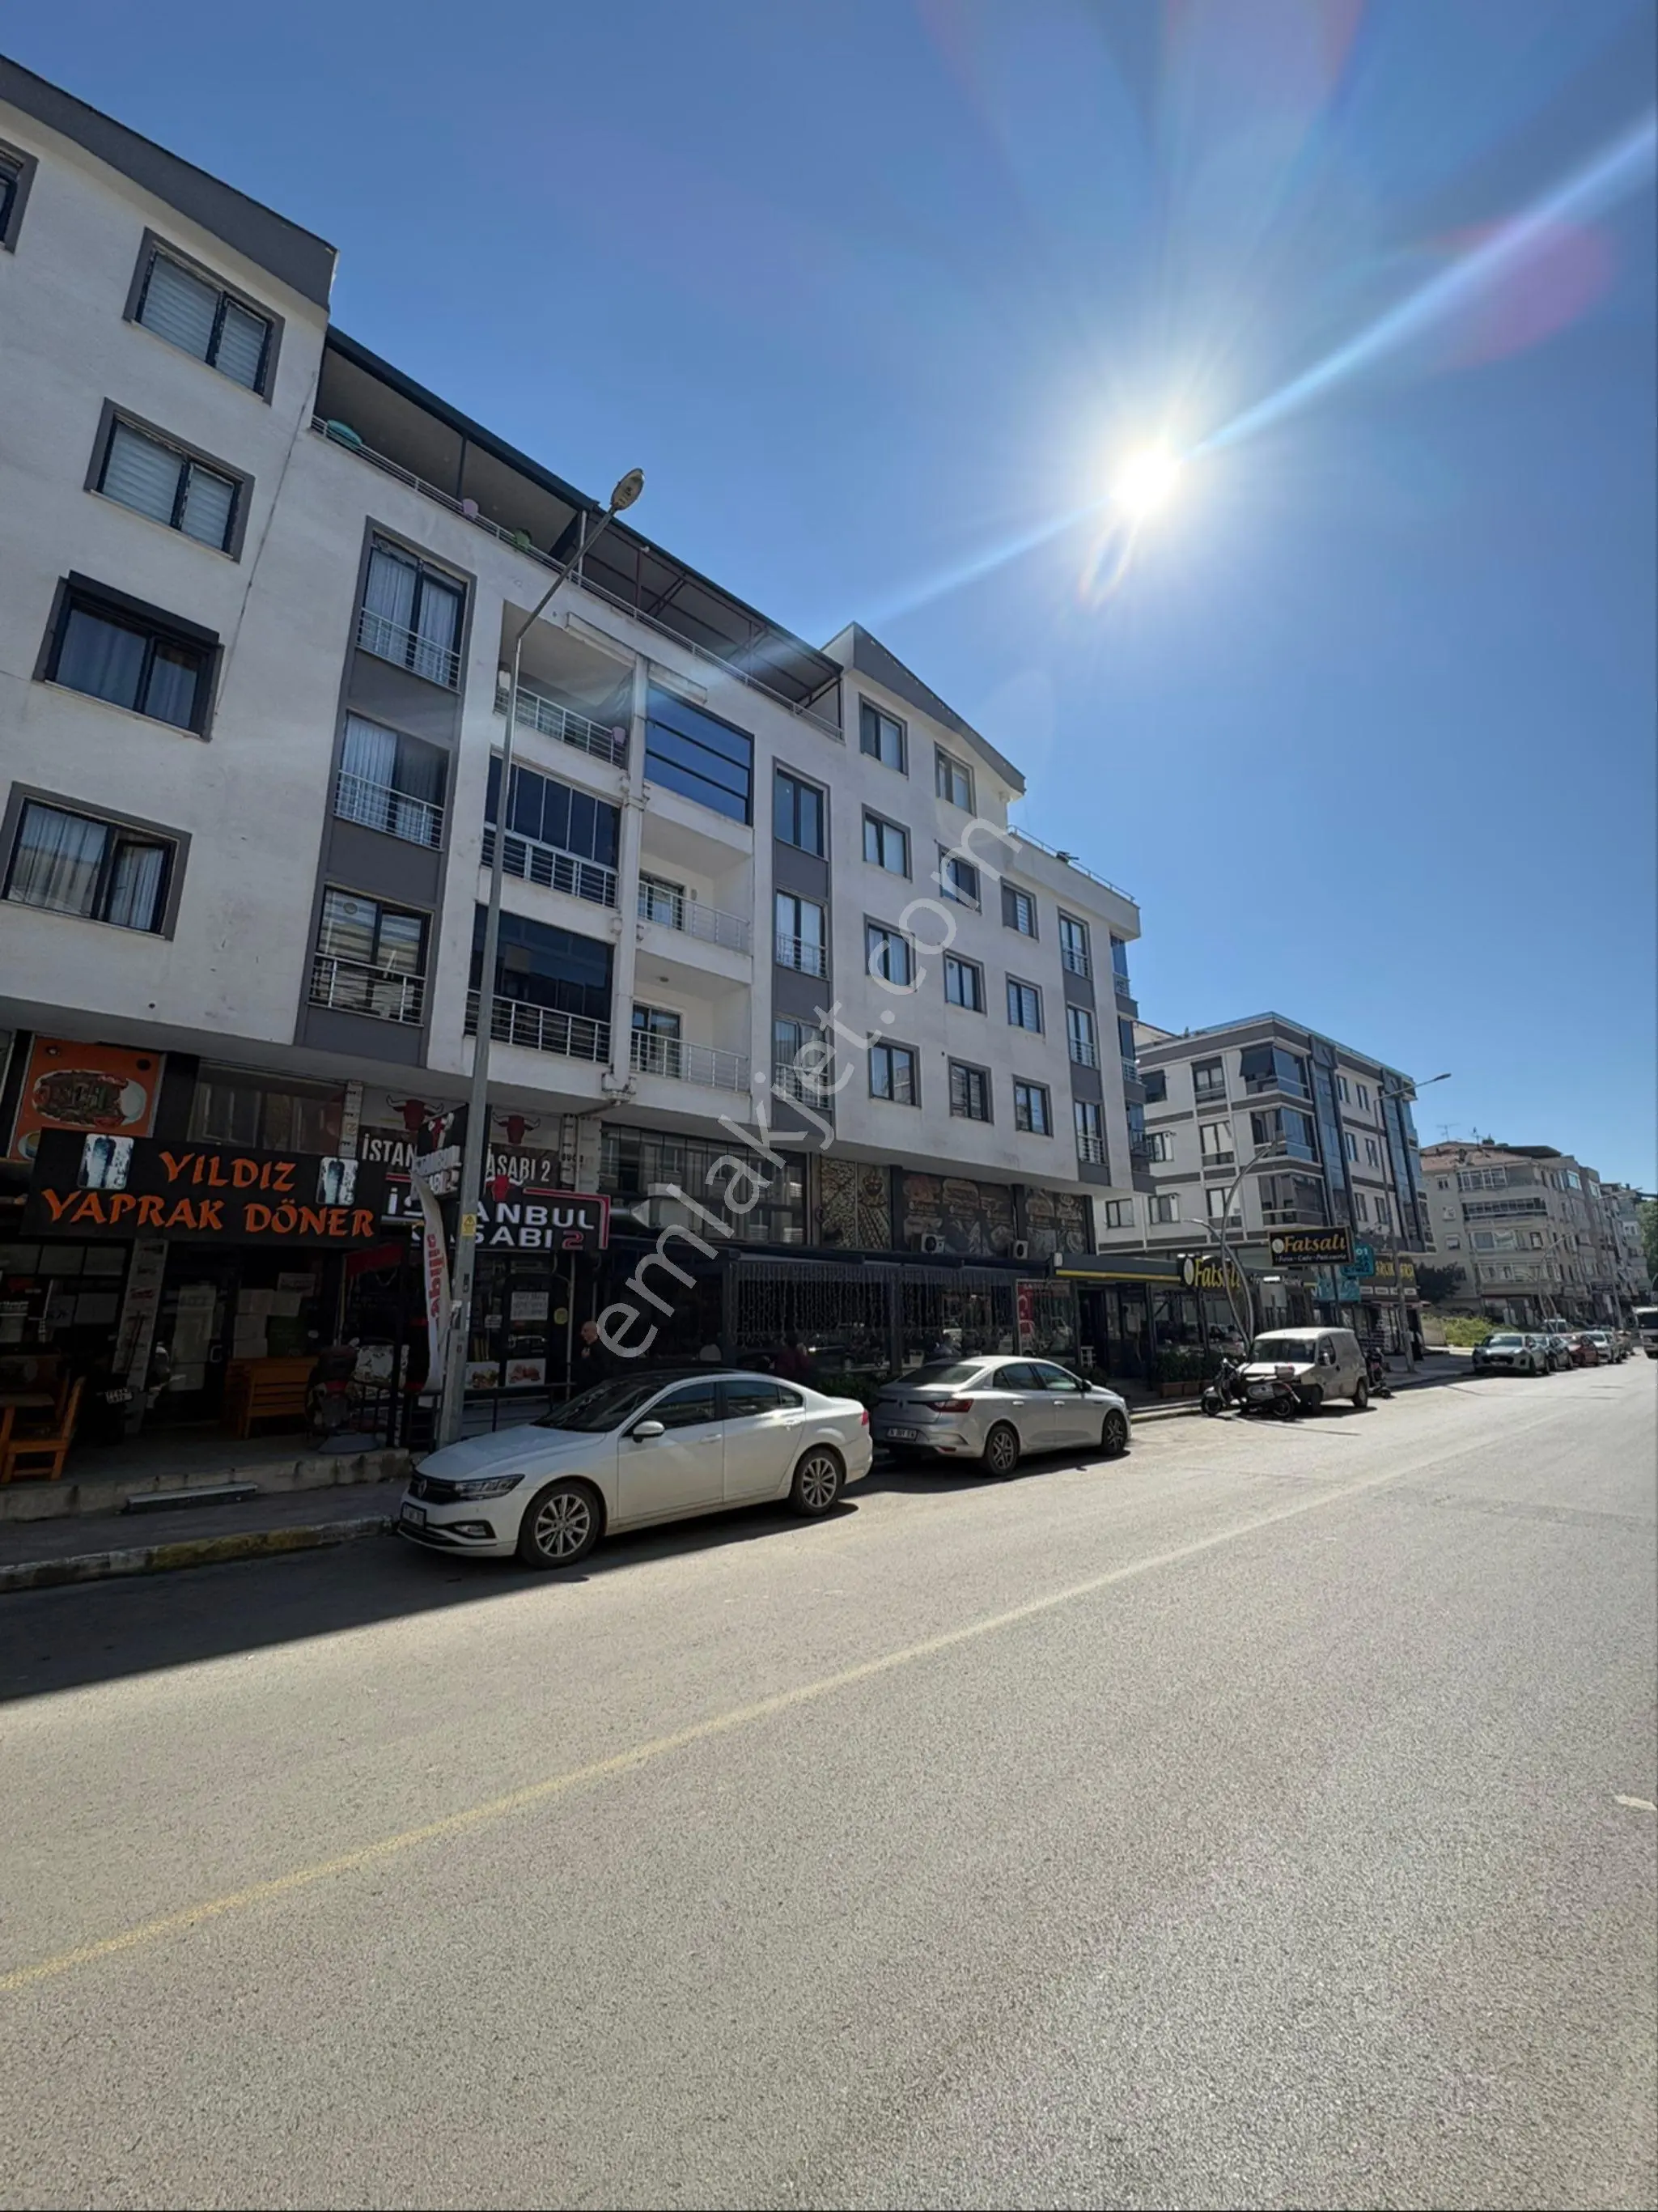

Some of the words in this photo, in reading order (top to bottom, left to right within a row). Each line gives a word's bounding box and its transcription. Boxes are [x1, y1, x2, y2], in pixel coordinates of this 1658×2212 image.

[159, 1150, 296, 1191] YILDIZ
[486, 1149, 536, 1181] ASABI
[541, 1160, 551, 1182] 2
[41, 1188, 225, 1231] YAPRAK
[244, 1198, 375, 1238] DÖNER
[387, 1187, 595, 1230] İANBUL
[411, 1223, 553, 1248] SABI
[562, 1230, 584, 1250] 2
[1284, 1233, 1347, 1253] Fatsalı
[1194, 1256, 1240, 1289] Fatslı
